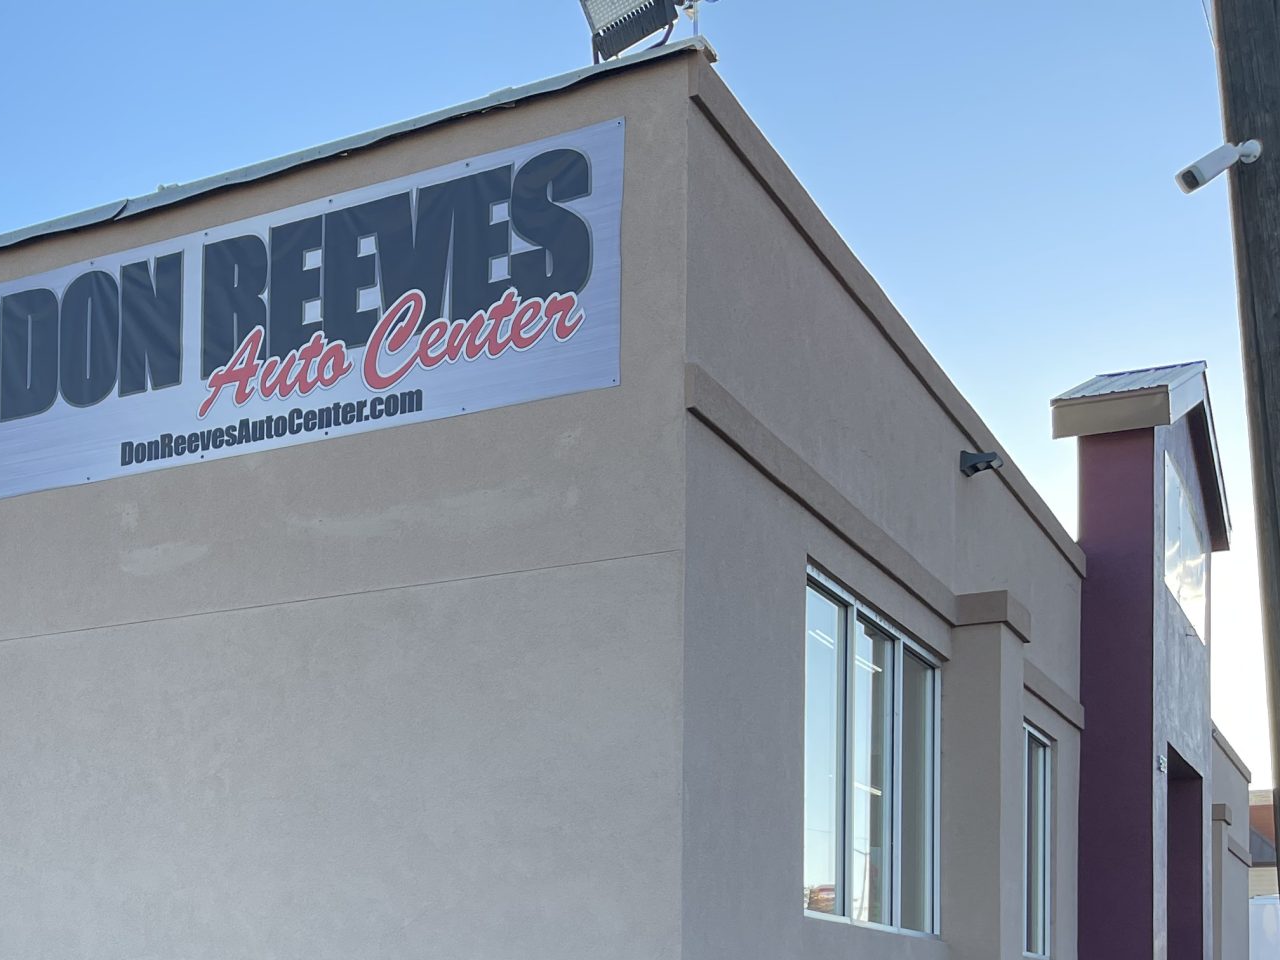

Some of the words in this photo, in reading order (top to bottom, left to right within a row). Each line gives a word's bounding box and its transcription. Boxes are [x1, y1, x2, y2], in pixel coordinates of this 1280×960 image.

[0, 251, 184, 423] DON
[201, 147, 594, 381] REEVES
[196, 324, 352, 418] Auto
[363, 287, 586, 392] Center
[120, 388, 424, 468] DonReevesAutoCenter.com
